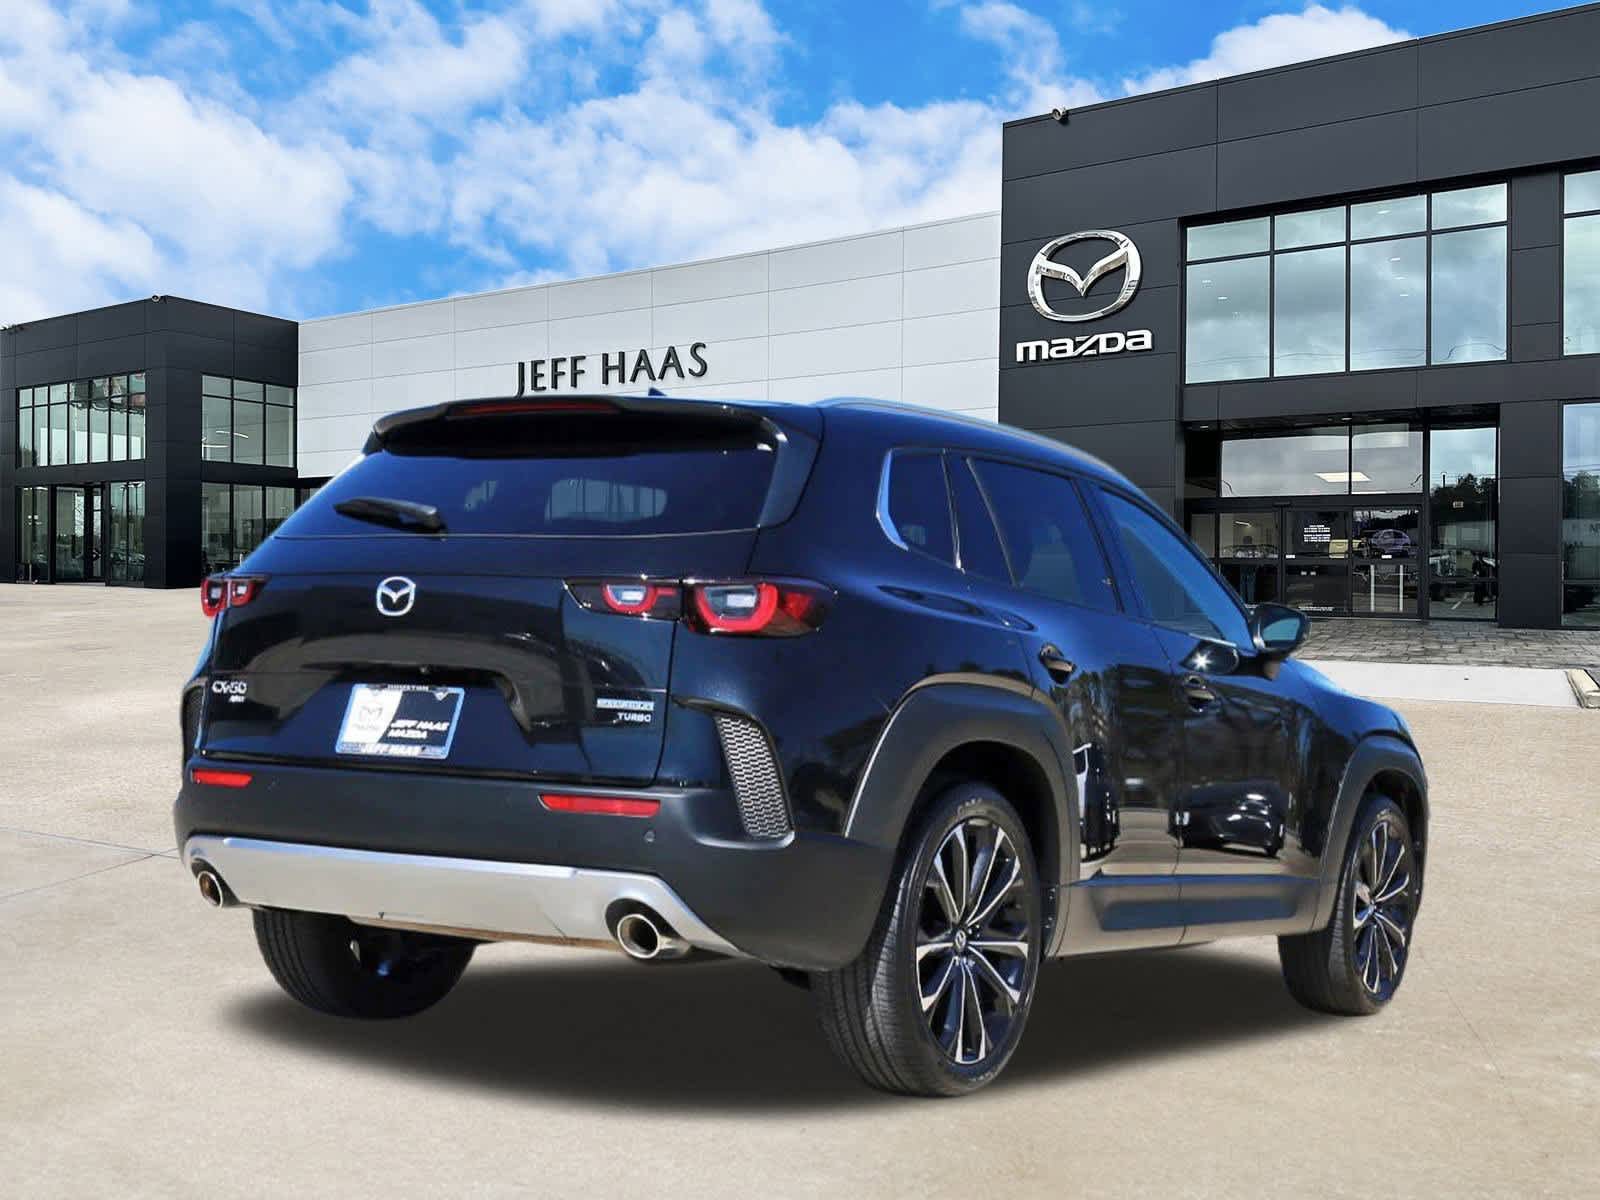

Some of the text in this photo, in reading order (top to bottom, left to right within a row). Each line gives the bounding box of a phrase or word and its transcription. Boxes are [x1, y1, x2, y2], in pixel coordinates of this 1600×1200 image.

[1016, 329, 1153, 362] mazda
[514, 342, 708, 399] JEFF HAAS
[617, 712, 652, 722] TURBO
